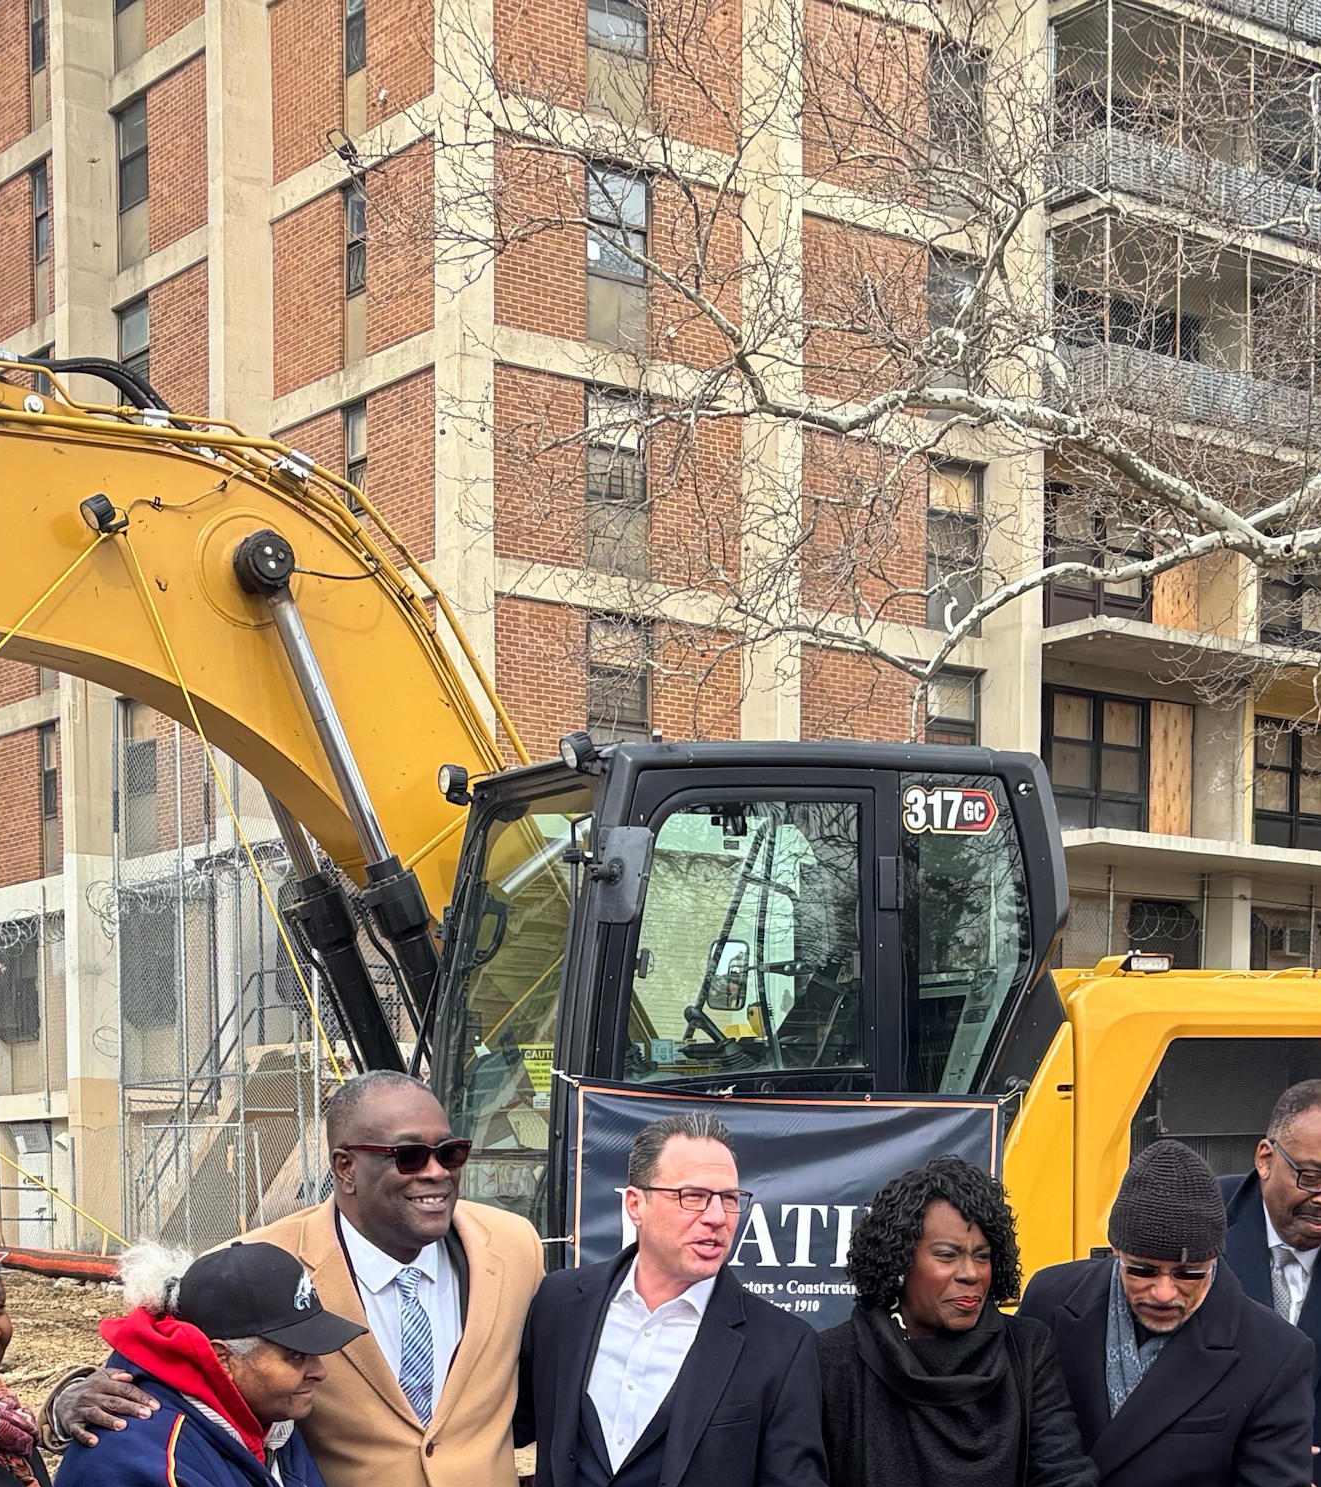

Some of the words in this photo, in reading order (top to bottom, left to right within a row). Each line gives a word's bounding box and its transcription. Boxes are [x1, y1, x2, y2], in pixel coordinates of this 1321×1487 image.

[906, 788, 963, 829] 317
[963, 800, 985, 821] GC
[524, 1049, 554, 1059] CAUTI
[794, 1300, 820, 1312] 1910
